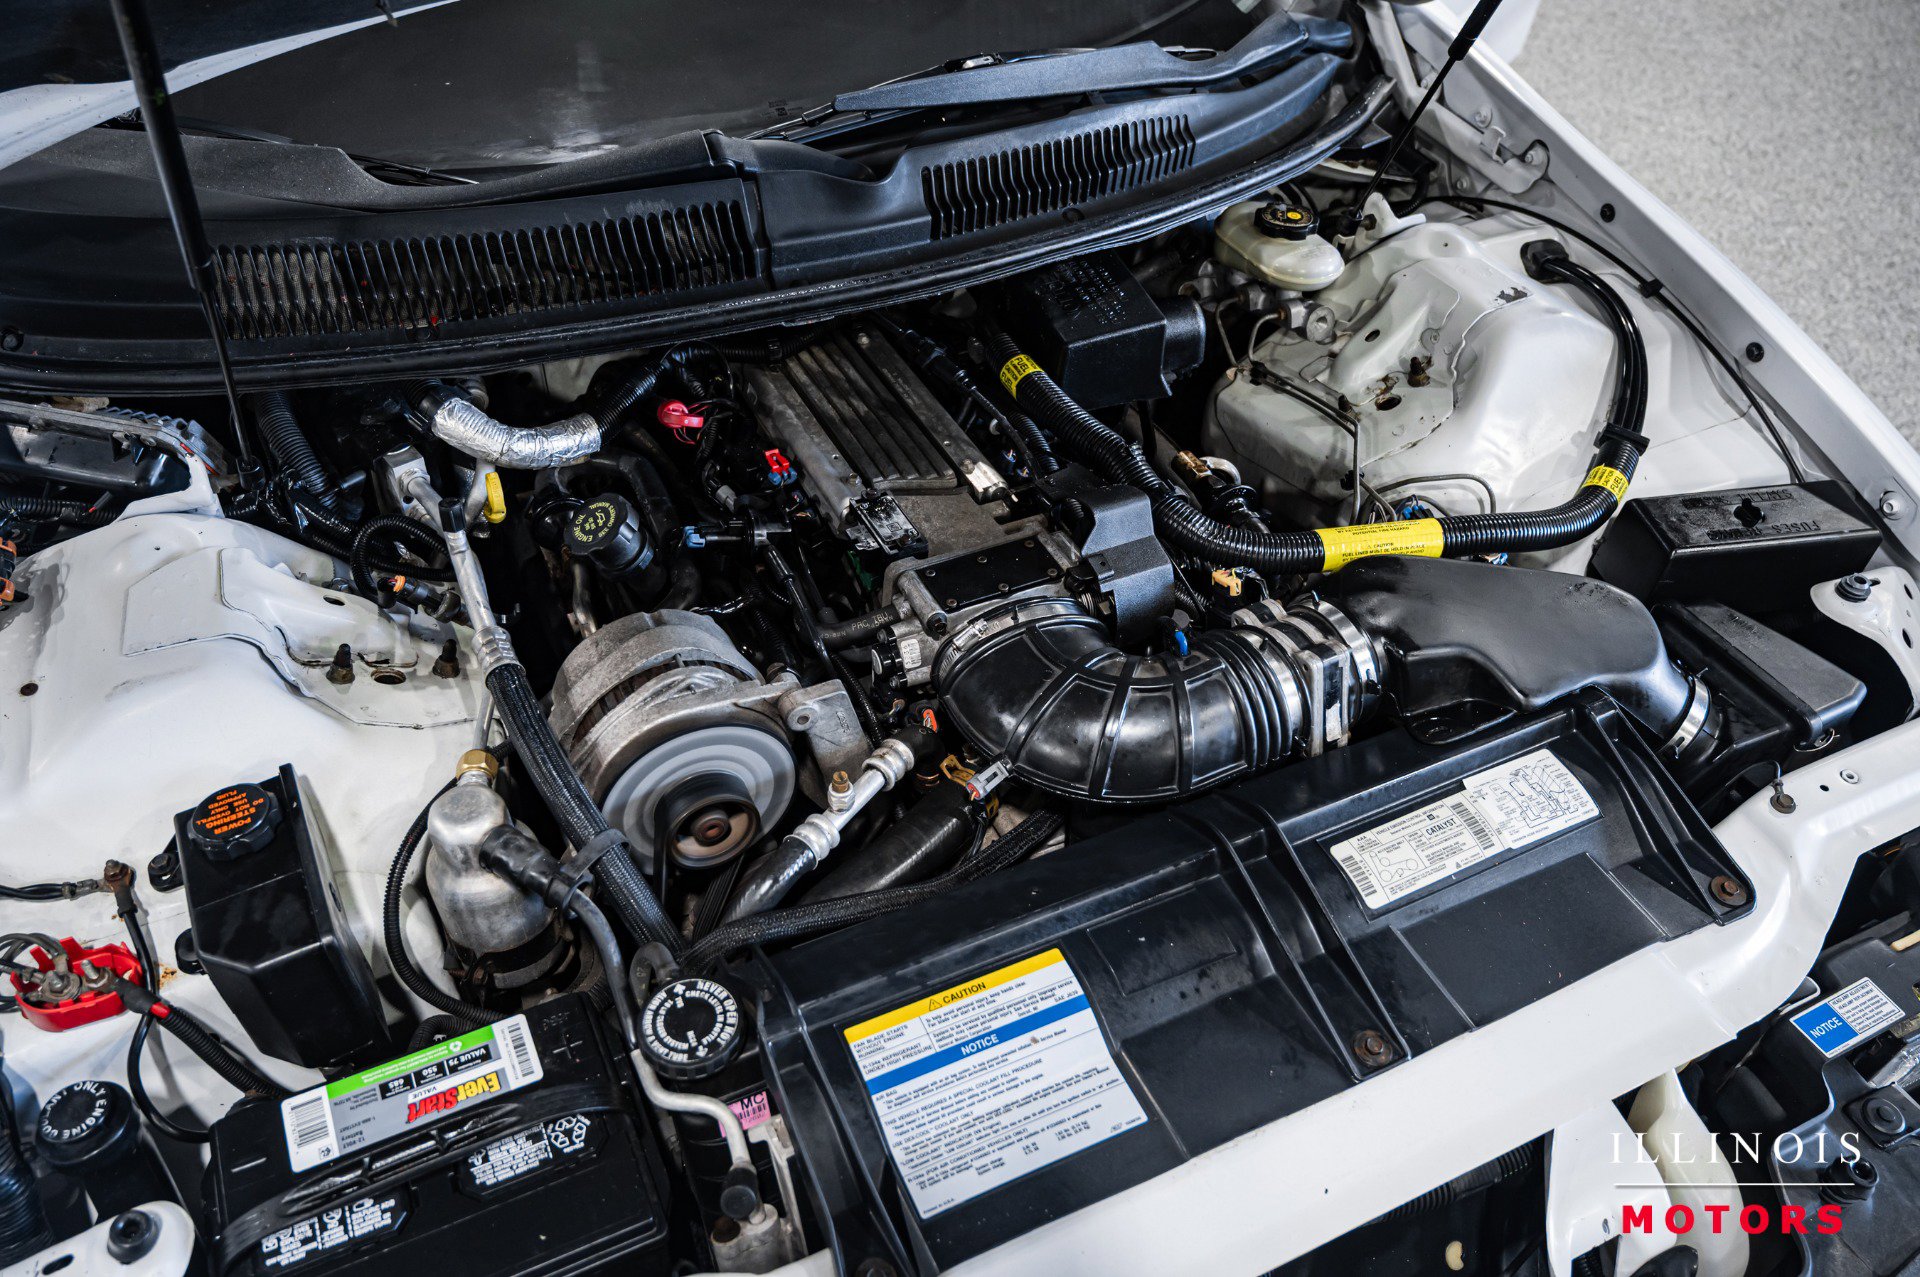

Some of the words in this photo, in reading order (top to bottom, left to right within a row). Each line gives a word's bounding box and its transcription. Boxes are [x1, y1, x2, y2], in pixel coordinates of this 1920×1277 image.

[1015, 356, 1029, 373] FUEL
[1608, 474, 1622, 491] FUEL
[576, 514, 586, 524] OIL
[574, 526, 593, 542] ENGINE
[208, 793, 246, 809] APPROVED
[217, 790, 236, 800] FLUID
[233, 798, 247, 807] USE
[252, 798, 264, 806] DO
[211, 805, 228, 815] ONLY
[236, 803, 250, 812] NOT
[196, 811, 230, 825] OVERFILL
[206, 807, 256, 828] STEERING
[214, 817, 251, 834] POWER
[1424, 817, 1457, 835] CATALYST
[685, 990, 710, 1000] CHECK
[697, 980, 728, 1000] NEVER
[942, 981, 986, 1004] CAUTION
[723, 999, 737, 1024] OPEN
[1809, 1015, 1842, 1038] NOTICE
[717, 1025, 735, 1046] HOT
[853, 1040, 865, 1048] FAN
[866, 1033, 884, 1043] BLADE
[885, 1023, 908, 1036] STARTS
[855, 1040, 882, 1053] WITHOUT
[883, 1031, 904, 1043] ENGINE
[959, 1032, 999, 1056] NOTICE
[459, 1046, 486, 1062] VALUE
[864, 1063, 885, 1075] UNDER
[886, 1057, 901, 1066] HIGH
[902, 1045, 932, 1060] PRESSURE
[881, 1042, 922, 1061] REFRIGERANT
[447, 1056, 459, 1066] 75
[420, 1064, 438, 1076] 550
[74, 1081, 106, 1096] ONLY
[388, 1077, 404, 1089] 685
[883, 1117, 897, 1126] THIS
[897, 1108, 919, 1121] VEHICLE
[920, 1096, 948, 1111] REQUIRES
[952, 1085, 974, 1098] SPECIAL
[974, 1075, 999, 1089] COOLANT
[999, 1070, 1011, 1078] FILL
[1010, 1057, 1042, 1074] PROCEDURE
[405, 1070, 501, 1124] EverStart
[411, 1085, 437, 1100] VALUE
[738, 1091, 765, 1110] MC
[875, 1093, 885, 1101] AIR
[62, 1099, 106, 1139] ENGINE
[934, 1116, 959, 1130] COOLANT
[960, 1110, 974, 1119] ONLY
[340, 1129, 363, 1142] Battery
